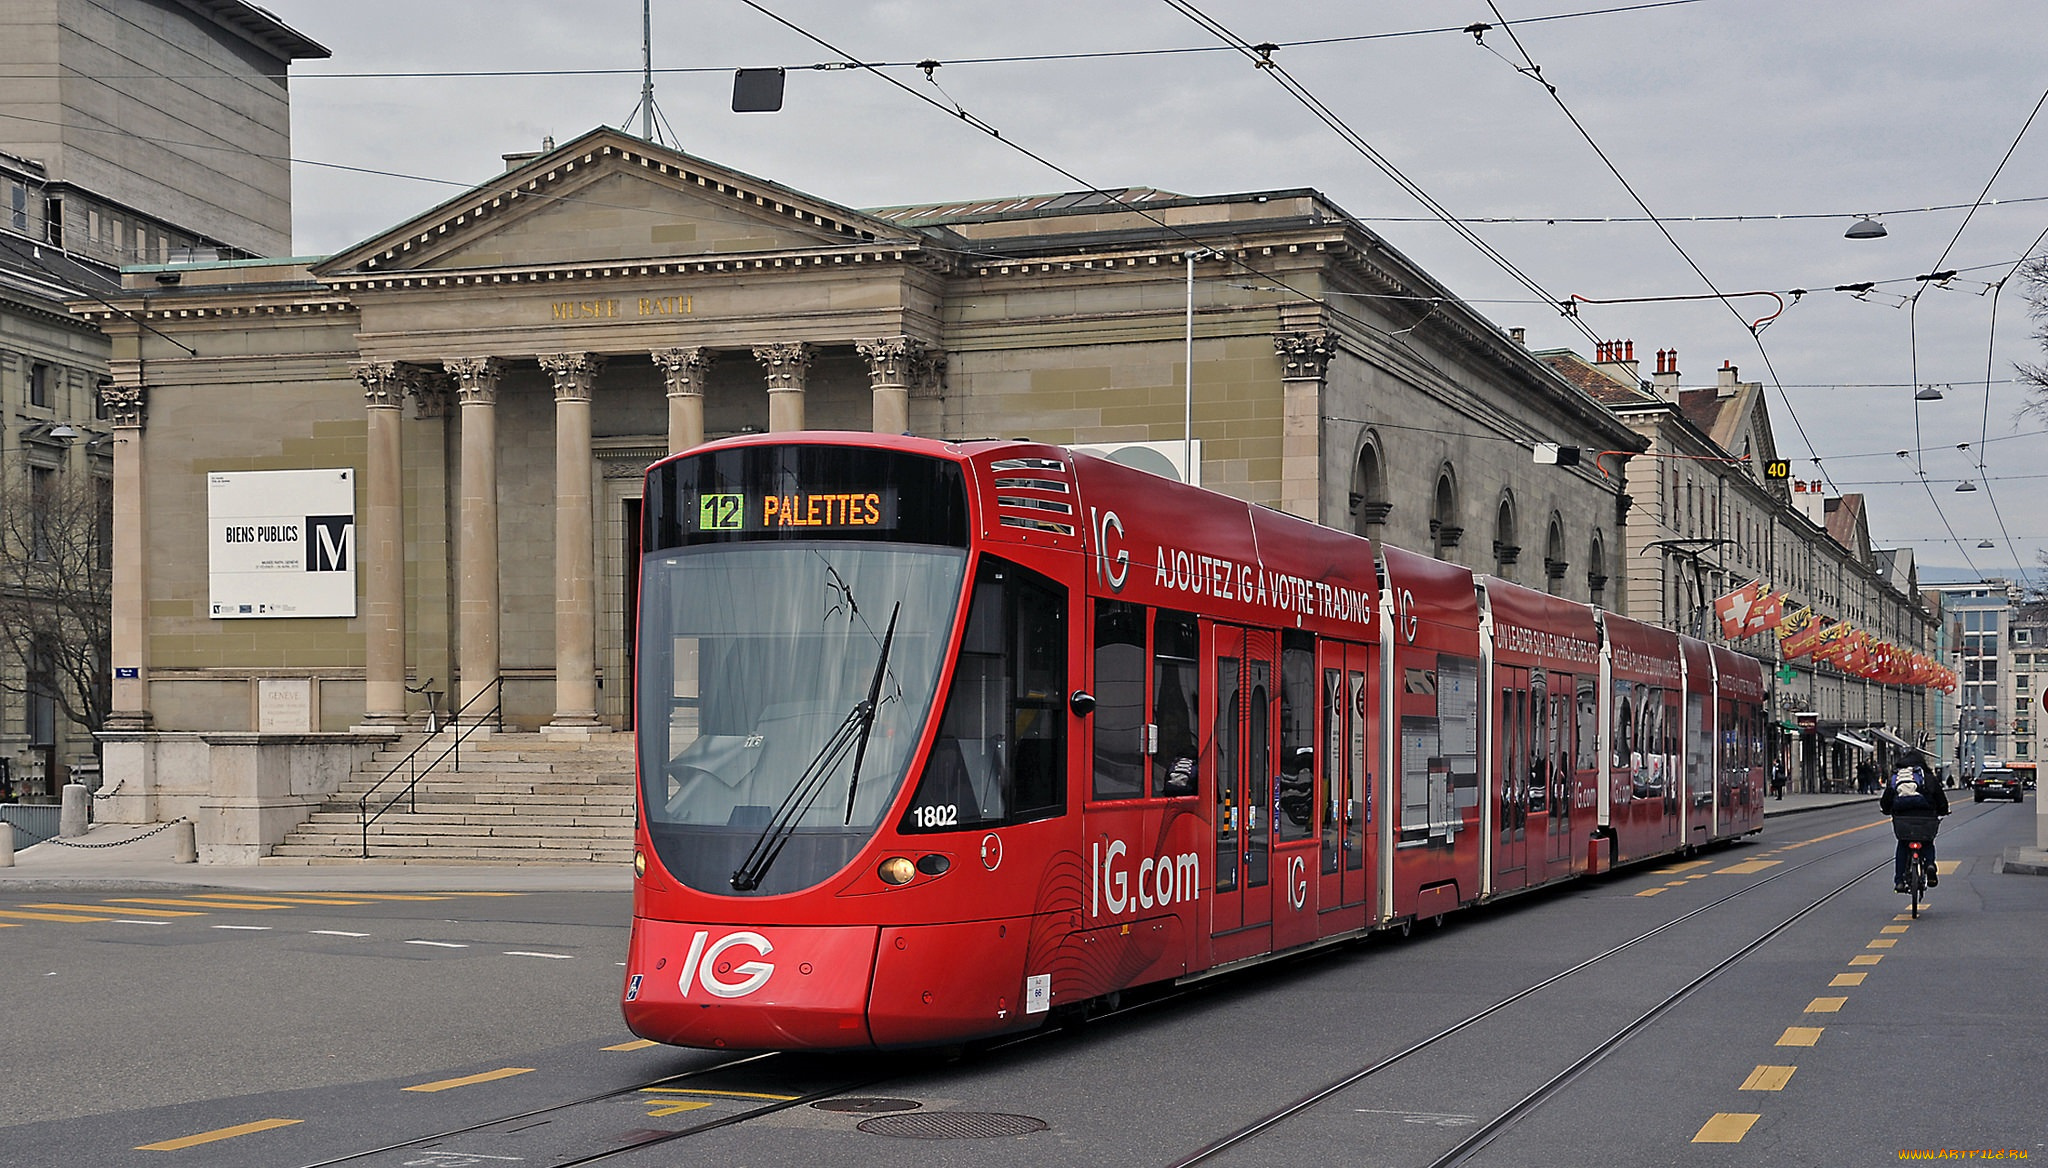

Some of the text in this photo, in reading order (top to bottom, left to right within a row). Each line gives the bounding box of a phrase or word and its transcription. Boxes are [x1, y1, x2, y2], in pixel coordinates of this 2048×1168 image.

[638, 295, 693, 316] RATH
[1767, 462, 1787, 477] 40
[704, 495, 739, 528] 12
[763, 493, 880, 527] PALETTES
[226, 524, 298, 543] BIENS PUBLICS
[1090, 506, 1130, 595] IG
[1155, 545, 1233, 600] AJOUTEZ
[1236, 563, 1253, 604] IG
[1269, 571, 1314, 615] VOTRE
[1316, 582, 1371, 625] TRADING
[1397, 586, 1418, 643] IG
[1495, 622, 1508, 650] UN
[1508, 625, 1533, 654] LEADER
[913, 804, 958, 828] 1802
[1092, 839, 1200, 918] IG.com
[1287, 855, 1307, 912] IG
[677, 930, 775, 999] IG
